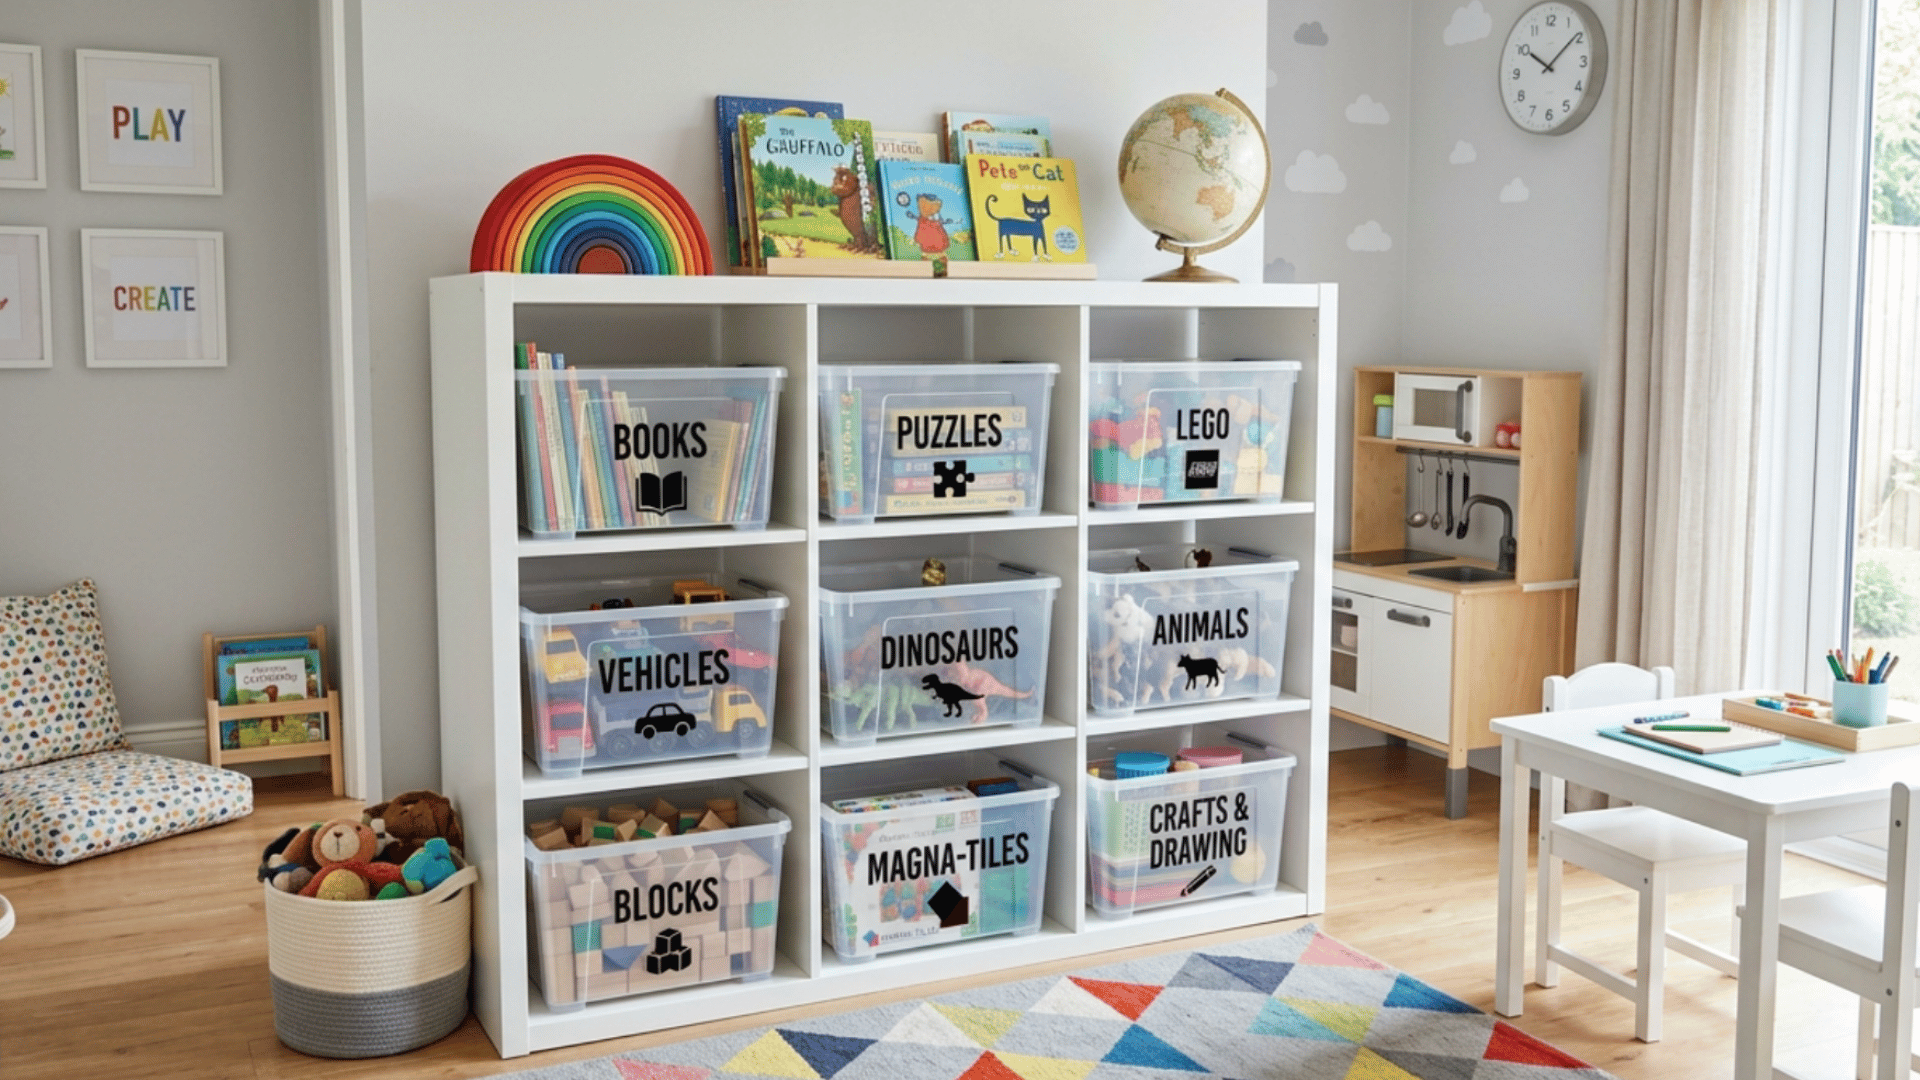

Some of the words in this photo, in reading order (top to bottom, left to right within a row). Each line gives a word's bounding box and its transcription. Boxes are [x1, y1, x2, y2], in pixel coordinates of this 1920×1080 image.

[1530, 24, 1539, 37] 11
[1545, 14, 1557, 27] 12
[1575, 31, 1584, 44] 2
[1515, 43, 1530, 56] 10
[1579, 55, 1588, 68] 3
[1512, 67, 1521, 80] 9
[1517, 89, 1526, 102] 8
[1574, 80, 1583, 92] 4
[1529, 104, 1537, 118] 7
[1545, 108, 1554, 121] 6
[1562, 99, 1571, 113] 5
[112, 105, 186, 142] PLAY
[1032, 163, 1065, 182] Cat
[113, 285, 196, 312] CREATE
[897, 413, 1003, 450] PUZZLES
[1176, 408, 1230, 441] LEGO
[613, 421, 707, 461] BOOKS
[1152, 607, 1250, 646] ANIMALS
[881, 625, 1019, 670] DINOSAURS
[598, 648, 730, 694] VEHICLES
[1149, 795, 1229, 834] CRAFTS
[1234, 792, 1249, 822] &
[867, 831, 1030, 886] MAGNA-TILES
[1149, 827, 1248, 870] DRAWING
[613, 876, 719, 924] BLOCKS
